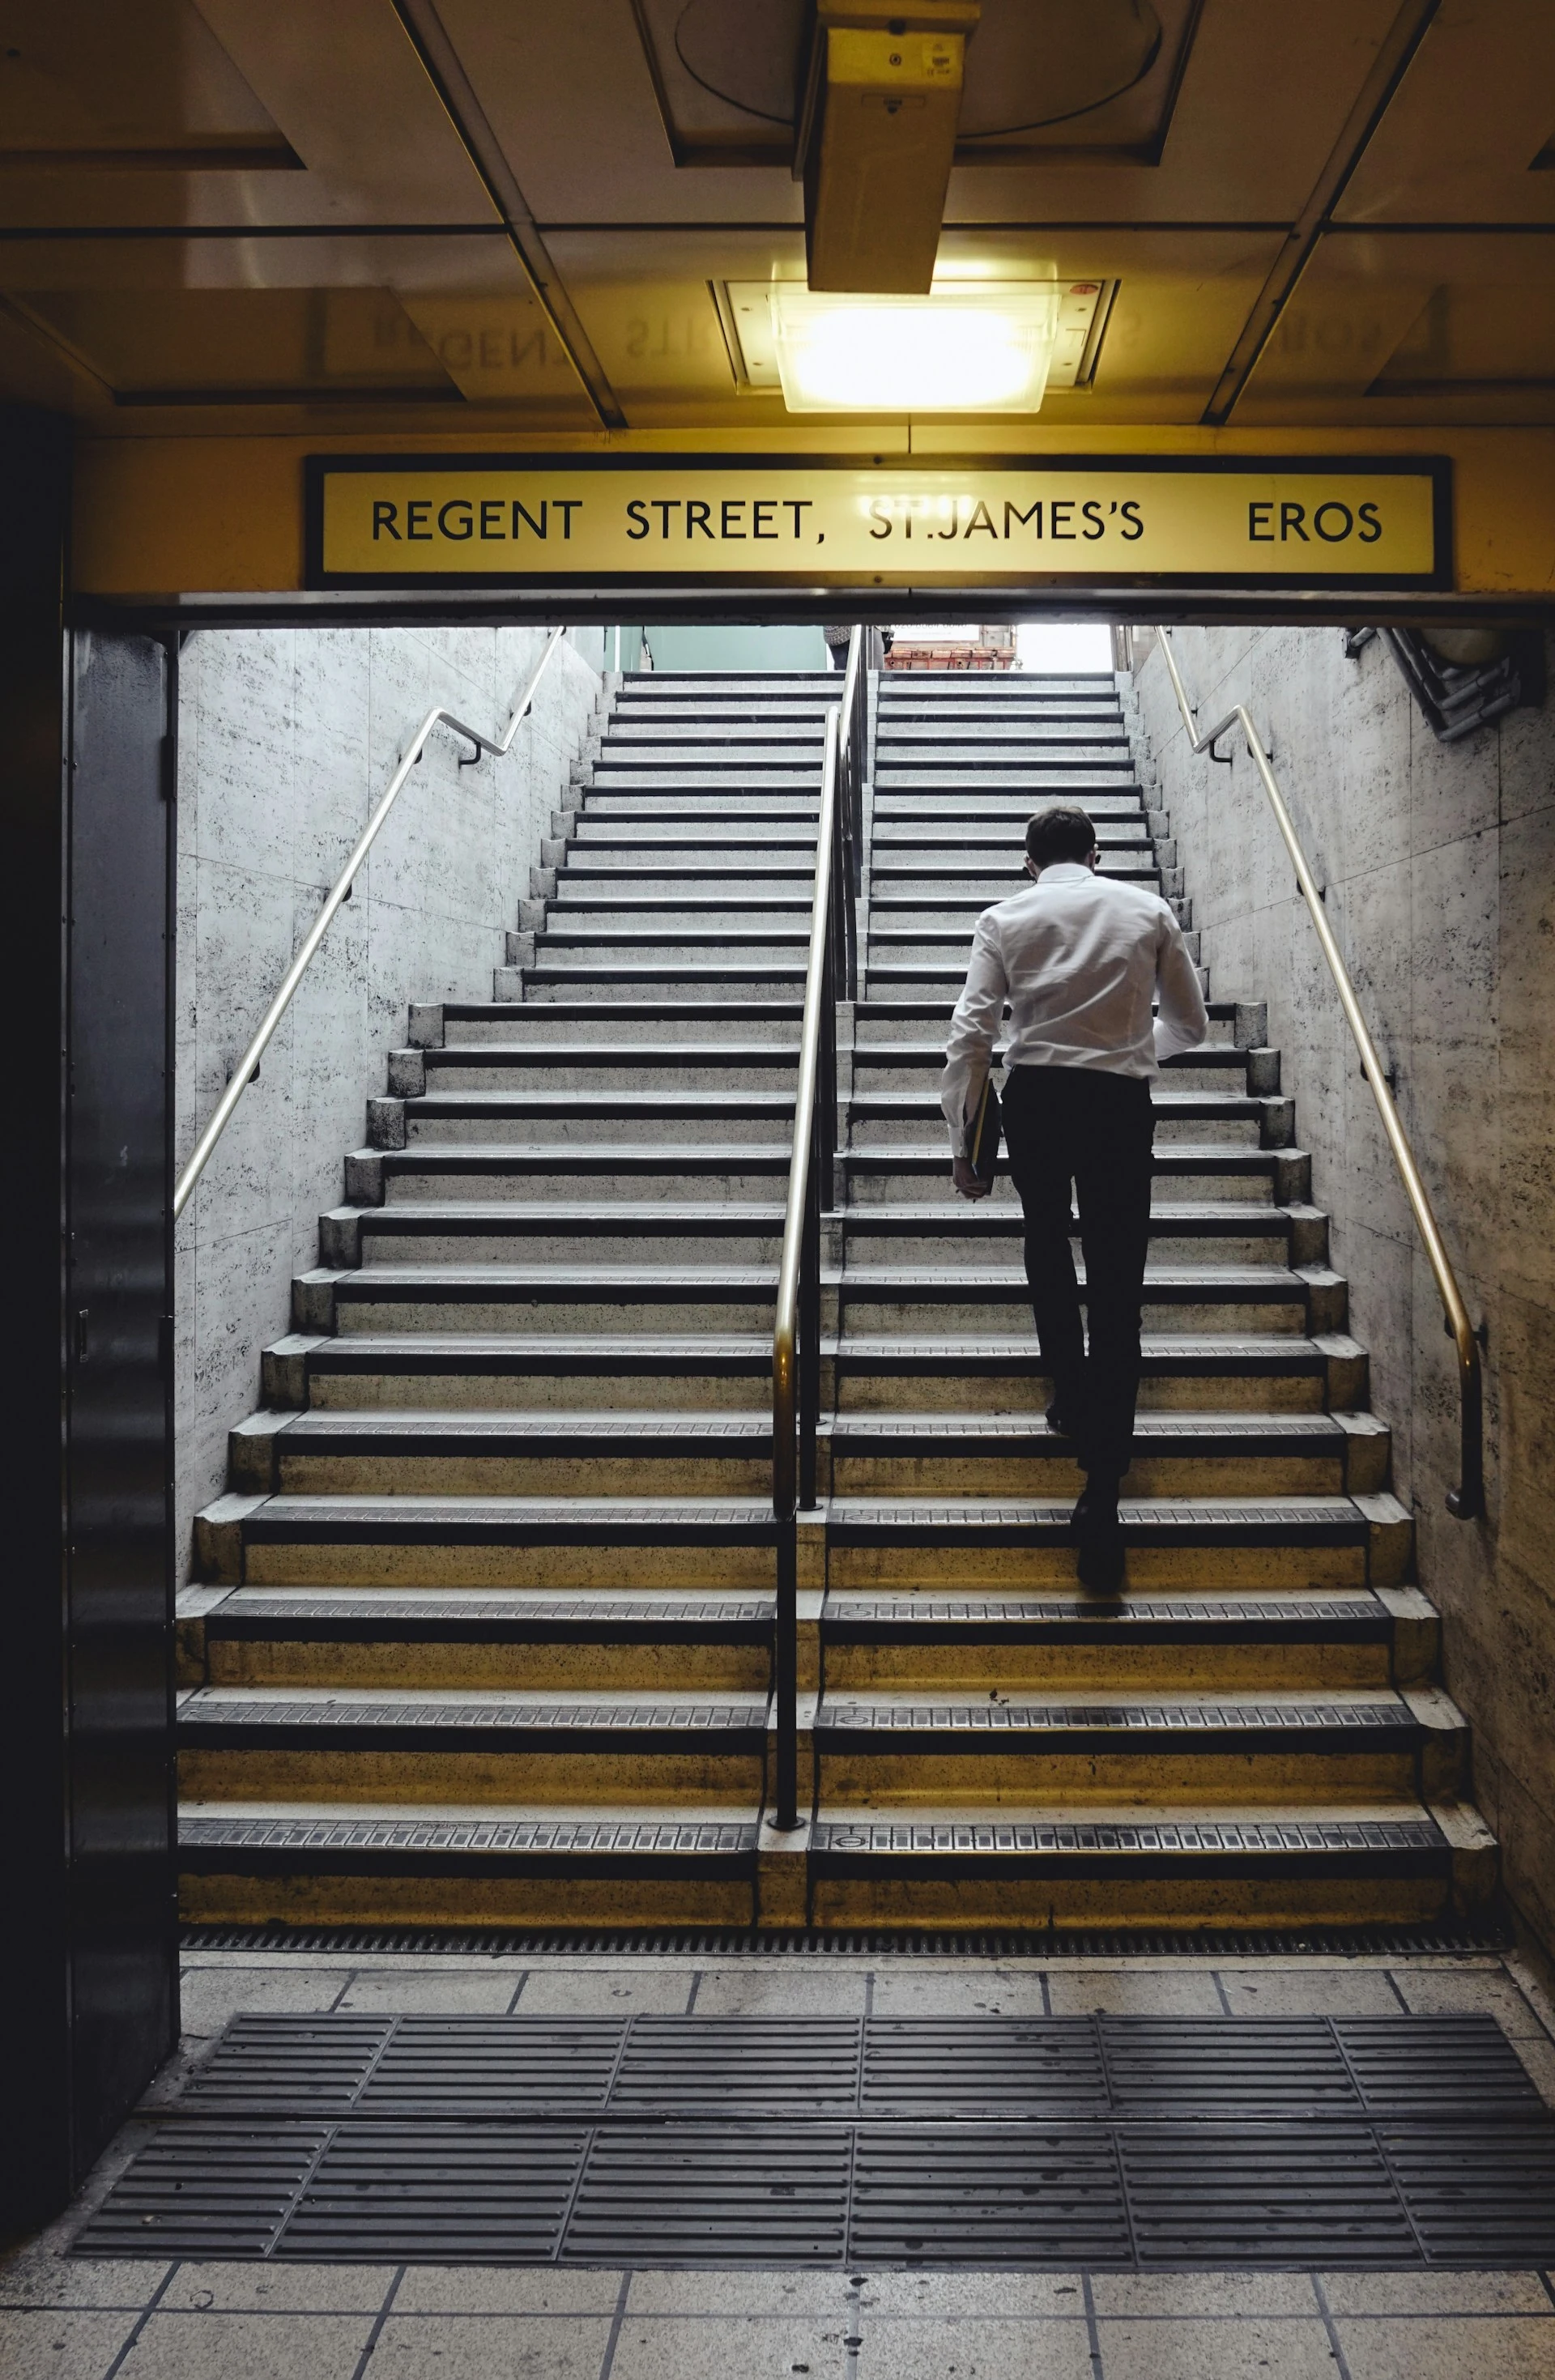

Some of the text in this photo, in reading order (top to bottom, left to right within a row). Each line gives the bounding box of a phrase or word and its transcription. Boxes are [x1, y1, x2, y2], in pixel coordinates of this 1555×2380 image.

[373, 500, 583, 541] REGENT
[625, 500, 824, 545] STREET,
[1249, 500, 1382, 543] EROS
